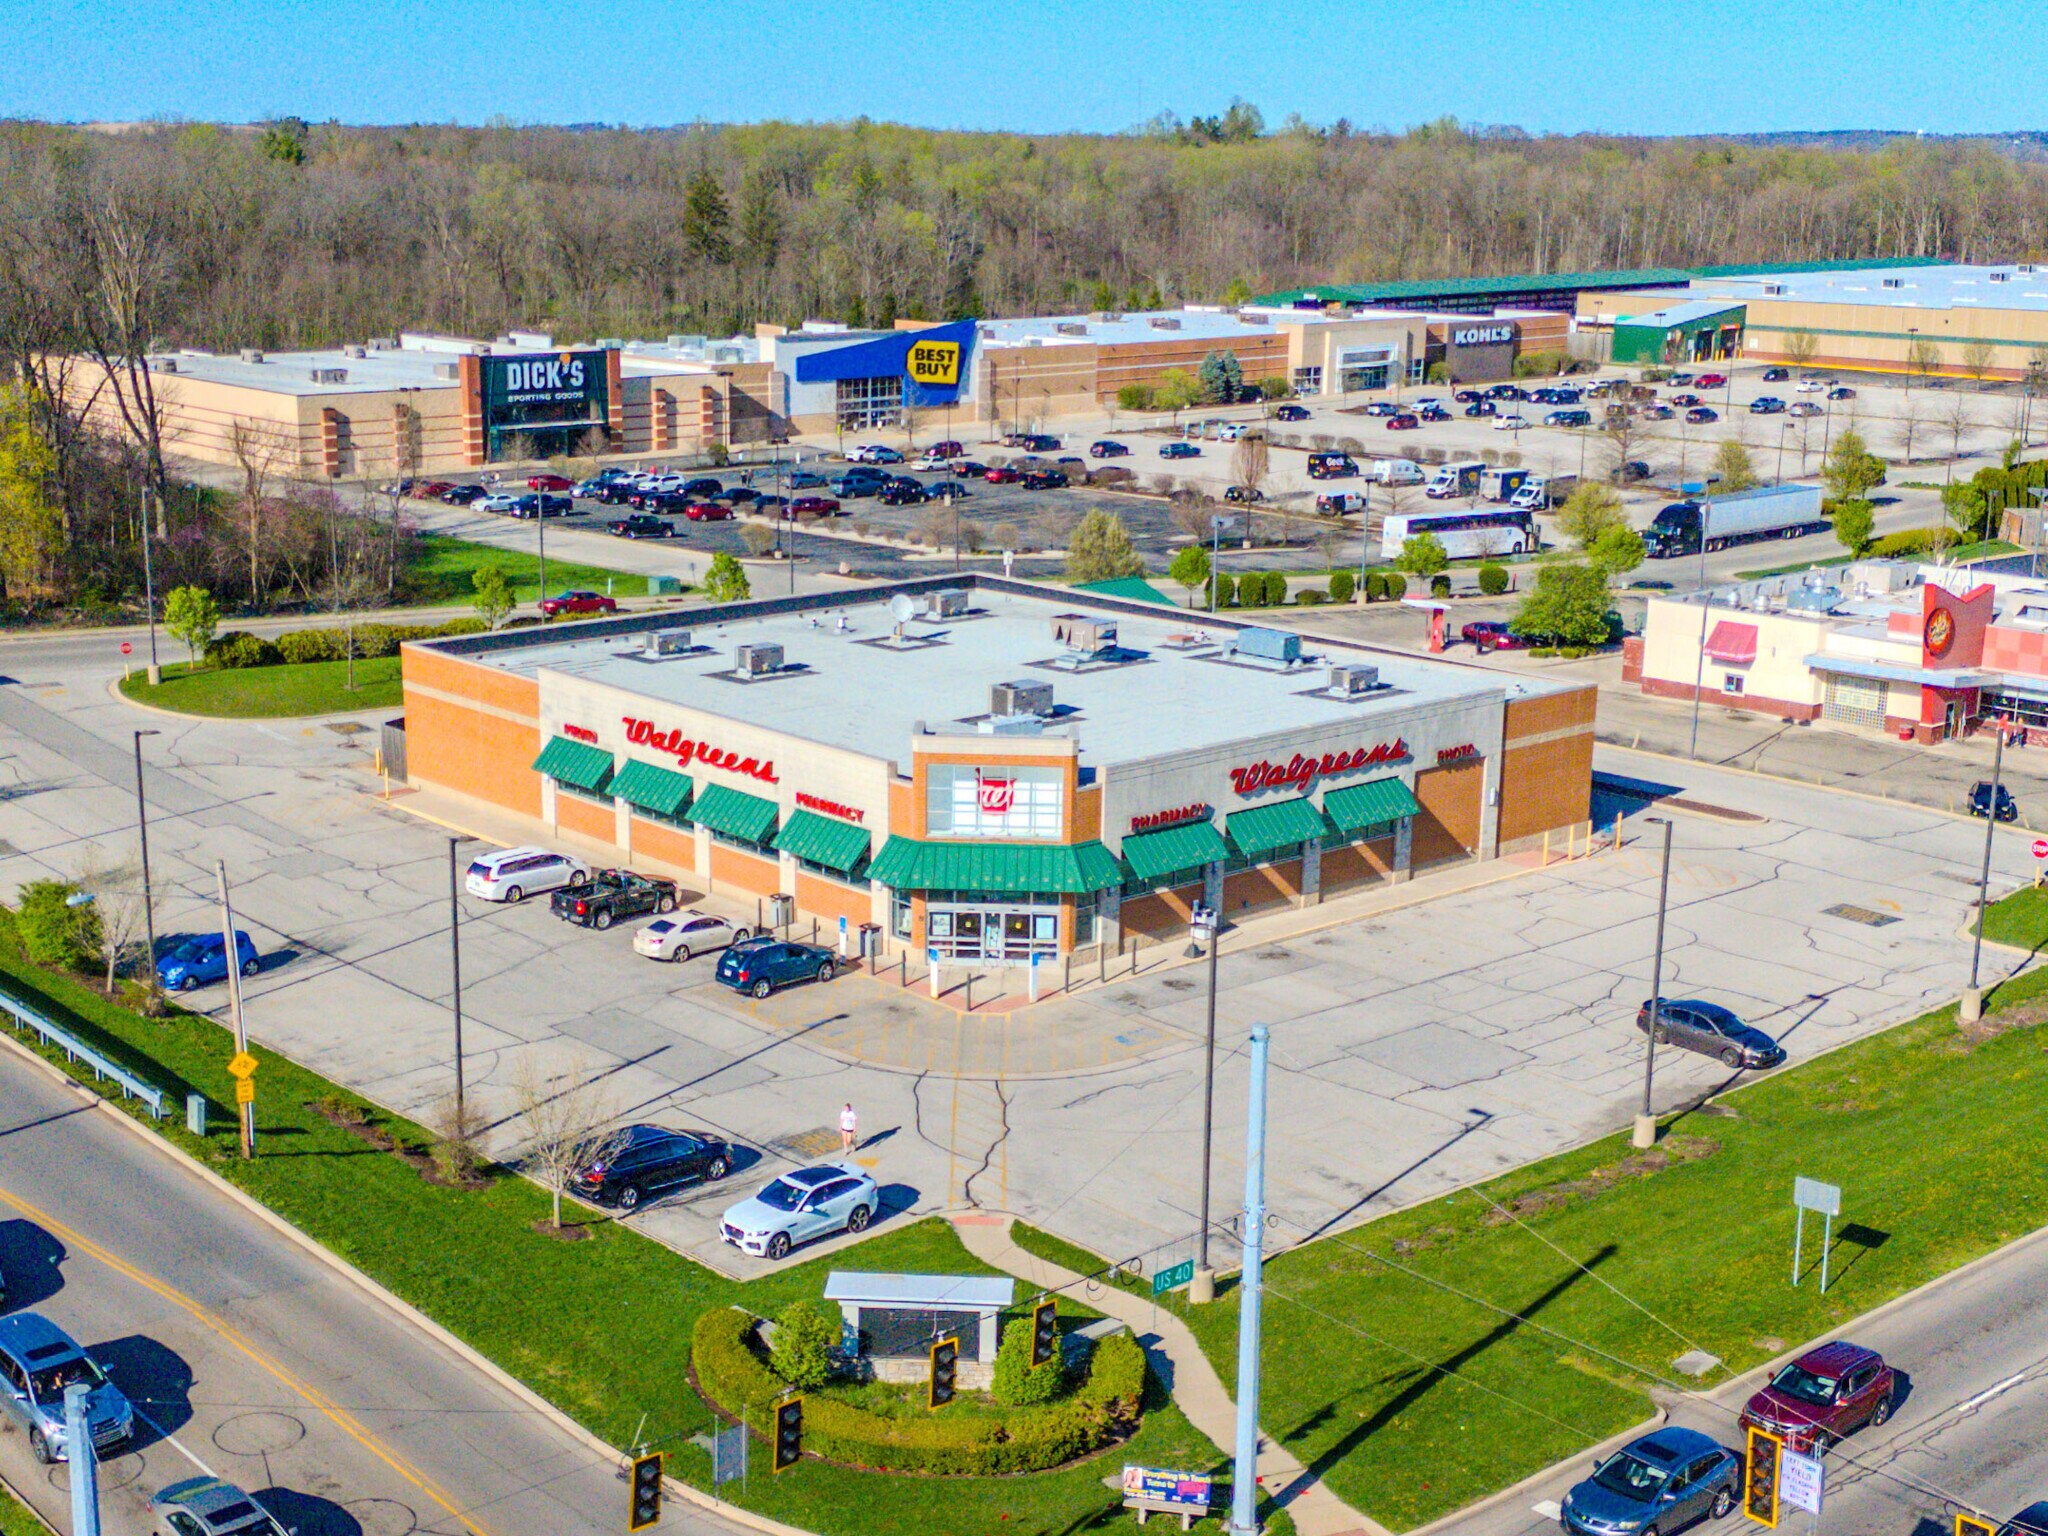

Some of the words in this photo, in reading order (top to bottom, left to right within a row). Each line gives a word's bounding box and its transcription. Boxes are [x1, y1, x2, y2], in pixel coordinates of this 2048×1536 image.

[1454, 326, 1511, 345] KOHL'S
[914, 348, 956, 363] BEST
[507, 360, 584, 391] DICK'S
[915, 362, 952, 377] BUY
[507, 394, 552, 403] SPORTING
[554, 391, 584, 401] GOODS
[622, 716, 780, 785] Walgreens
[1437, 743, 1475, 762] PHOTO
[1229, 737, 1408, 794] Walgreens
[796, 791, 865, 824] PHARMACY
[1131, 801, 1207, 832] PHARMACY
[1156, 1271, 1171, 1291] US
[1175, 1264, 1190, 1283] 40
[1791, 1467, 1812, 1481] YIELD
